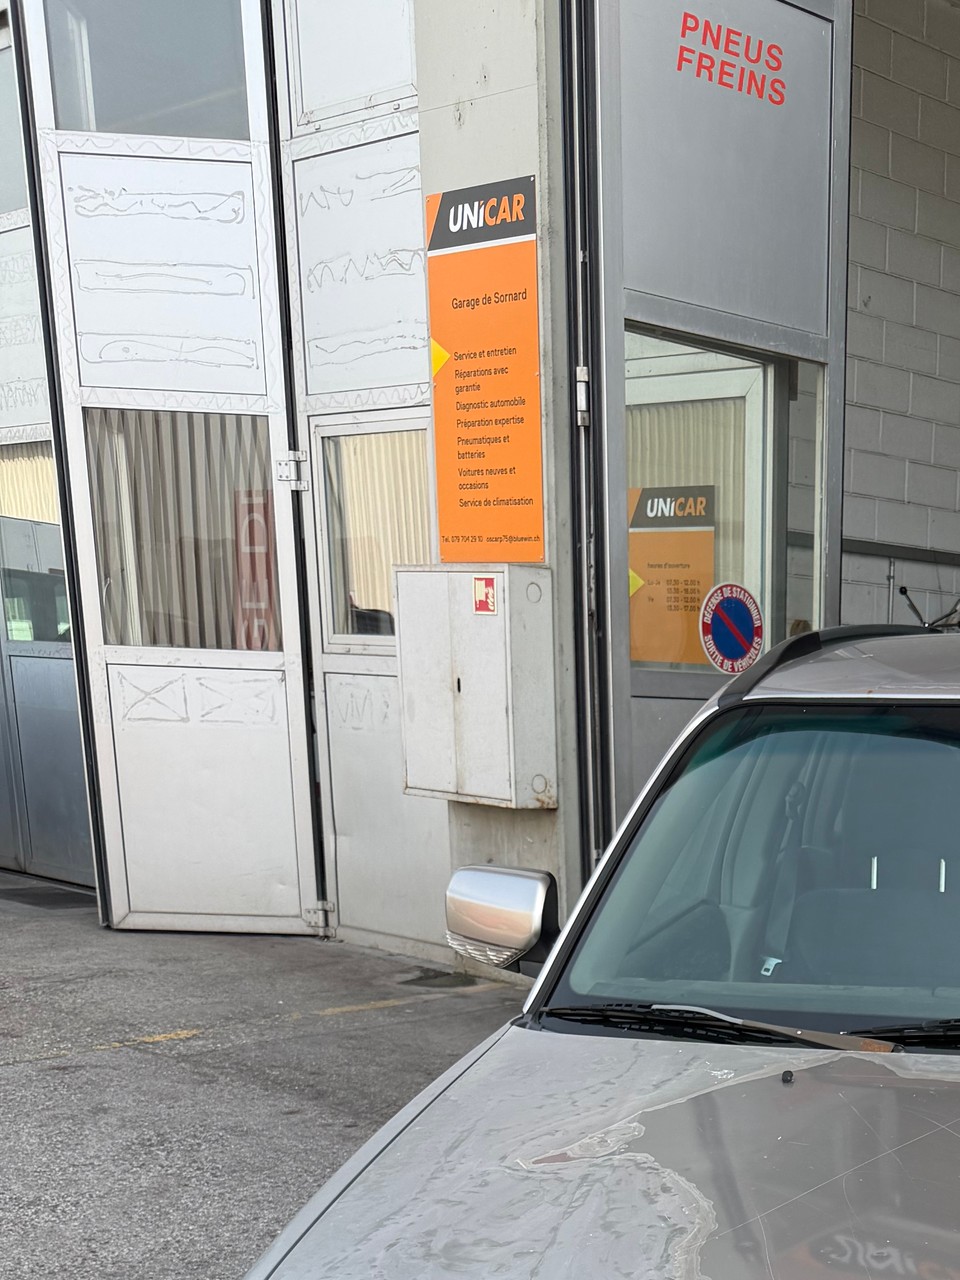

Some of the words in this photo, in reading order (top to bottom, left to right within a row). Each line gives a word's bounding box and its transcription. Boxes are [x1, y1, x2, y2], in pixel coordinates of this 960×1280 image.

[681, 11, 784, 72] PNEUS
[676, 45, 787, 106] FREINS
[451, 297, 480, 310] Garage
[481, 294, 492, 305] de
[493, 288, 527, 303] Sornard
[453, 351, 477, 361] Service
[478, 349, 486, 358] et
[486, 347, 517, 357] entretien
[454, 367, 492, 380] Réparations
[493, 366, 509, 375] avec
[455, 383, 481, 395] garantie
[456, 399, 489, 413] Diagnostic
[489, 397, 526, 410] automobile
[456, 417, 493, 430] Préparation
[494, 415, 525, 427] expertise
[457, 435, 502, 446] Pneumatiques
[502, 435, 510, 443] et
[457, 450, 485, 460] batteries
[458, 466, 484, 477] Voitures
[485, 467, 508, 476] neuves
[508, 466, 516, 475] et
[458, 481, 489, 491] occasions
[459, 498, 483, 508] Service
[483, 497, 492, 507] de
[492, 496, 534, 507] climatisation
[722, 586, 733, 597] DE
[732, 587, 762, 628] STATIONNER
[704, 634, 723, 667] SORTIE
[722, 659, 733, 672] DE
